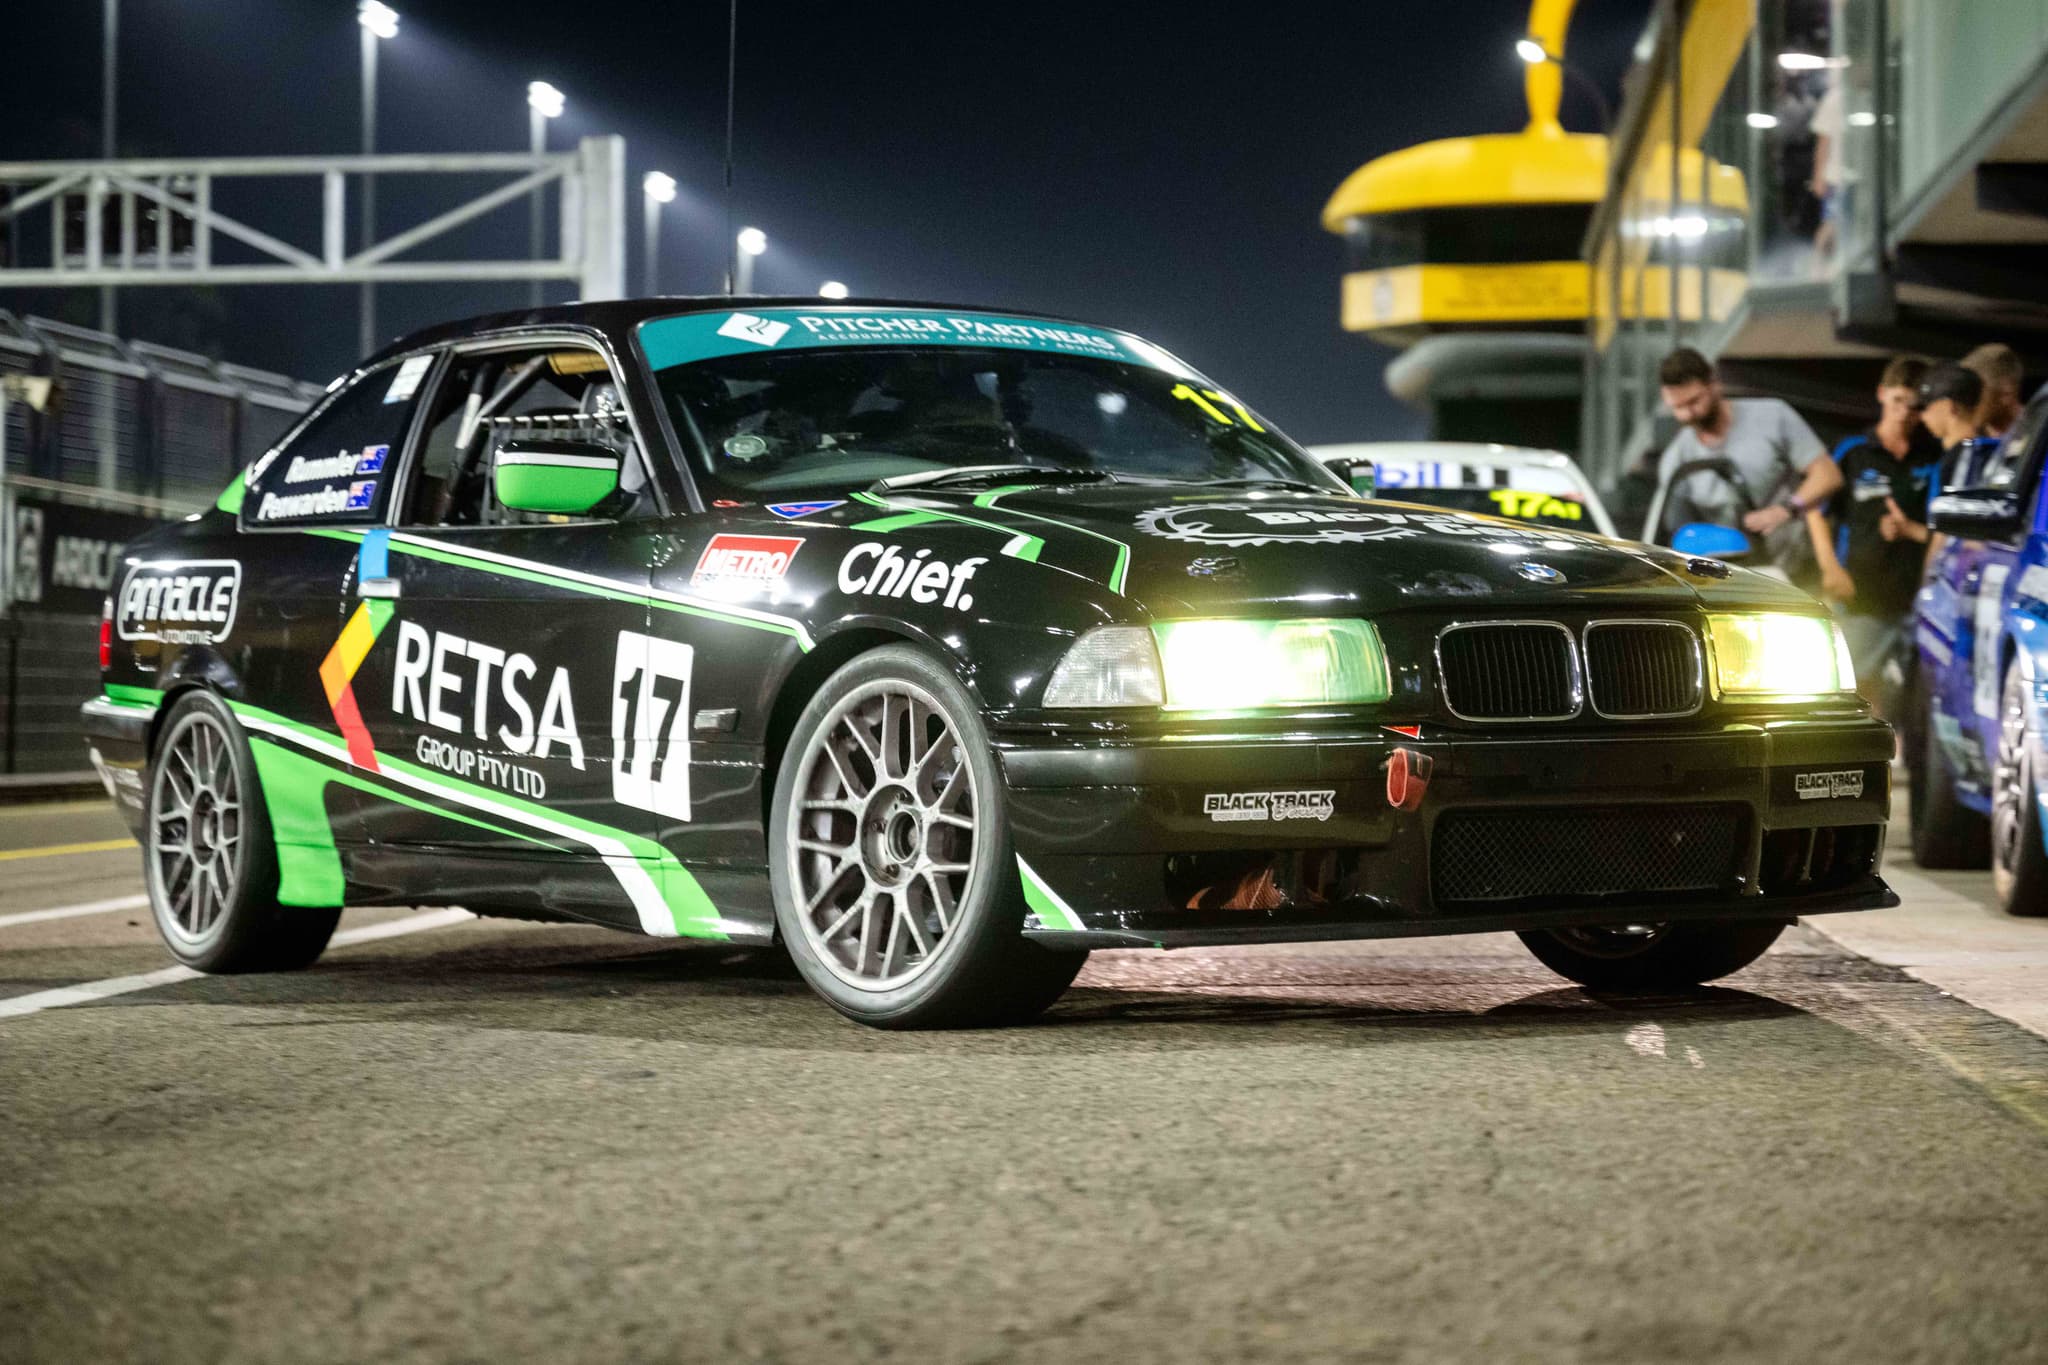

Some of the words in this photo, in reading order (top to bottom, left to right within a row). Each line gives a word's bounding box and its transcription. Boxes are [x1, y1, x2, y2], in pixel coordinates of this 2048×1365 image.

[797, 316, 950, 334] PITCHER
[946, 317, 1116, 350] PARTNERS
[1171, 383, 1266, 433] 17
[702, 548, 788, 576] METRO
[837, 542, 990, 612] Chief.
[392, 619, 586, 771] RETSA
[618, 667, 685, 783] 17
[416, 735, 475, 777] GROUP
[478, 754, 511, 789] PTY
[511, 765, 546, 799] LTD
[1797, 773, 1829, 790] BLACK
[1206, 795, 1268, 811] BLACK
[1272, 792, 1333, 808] TRACK
